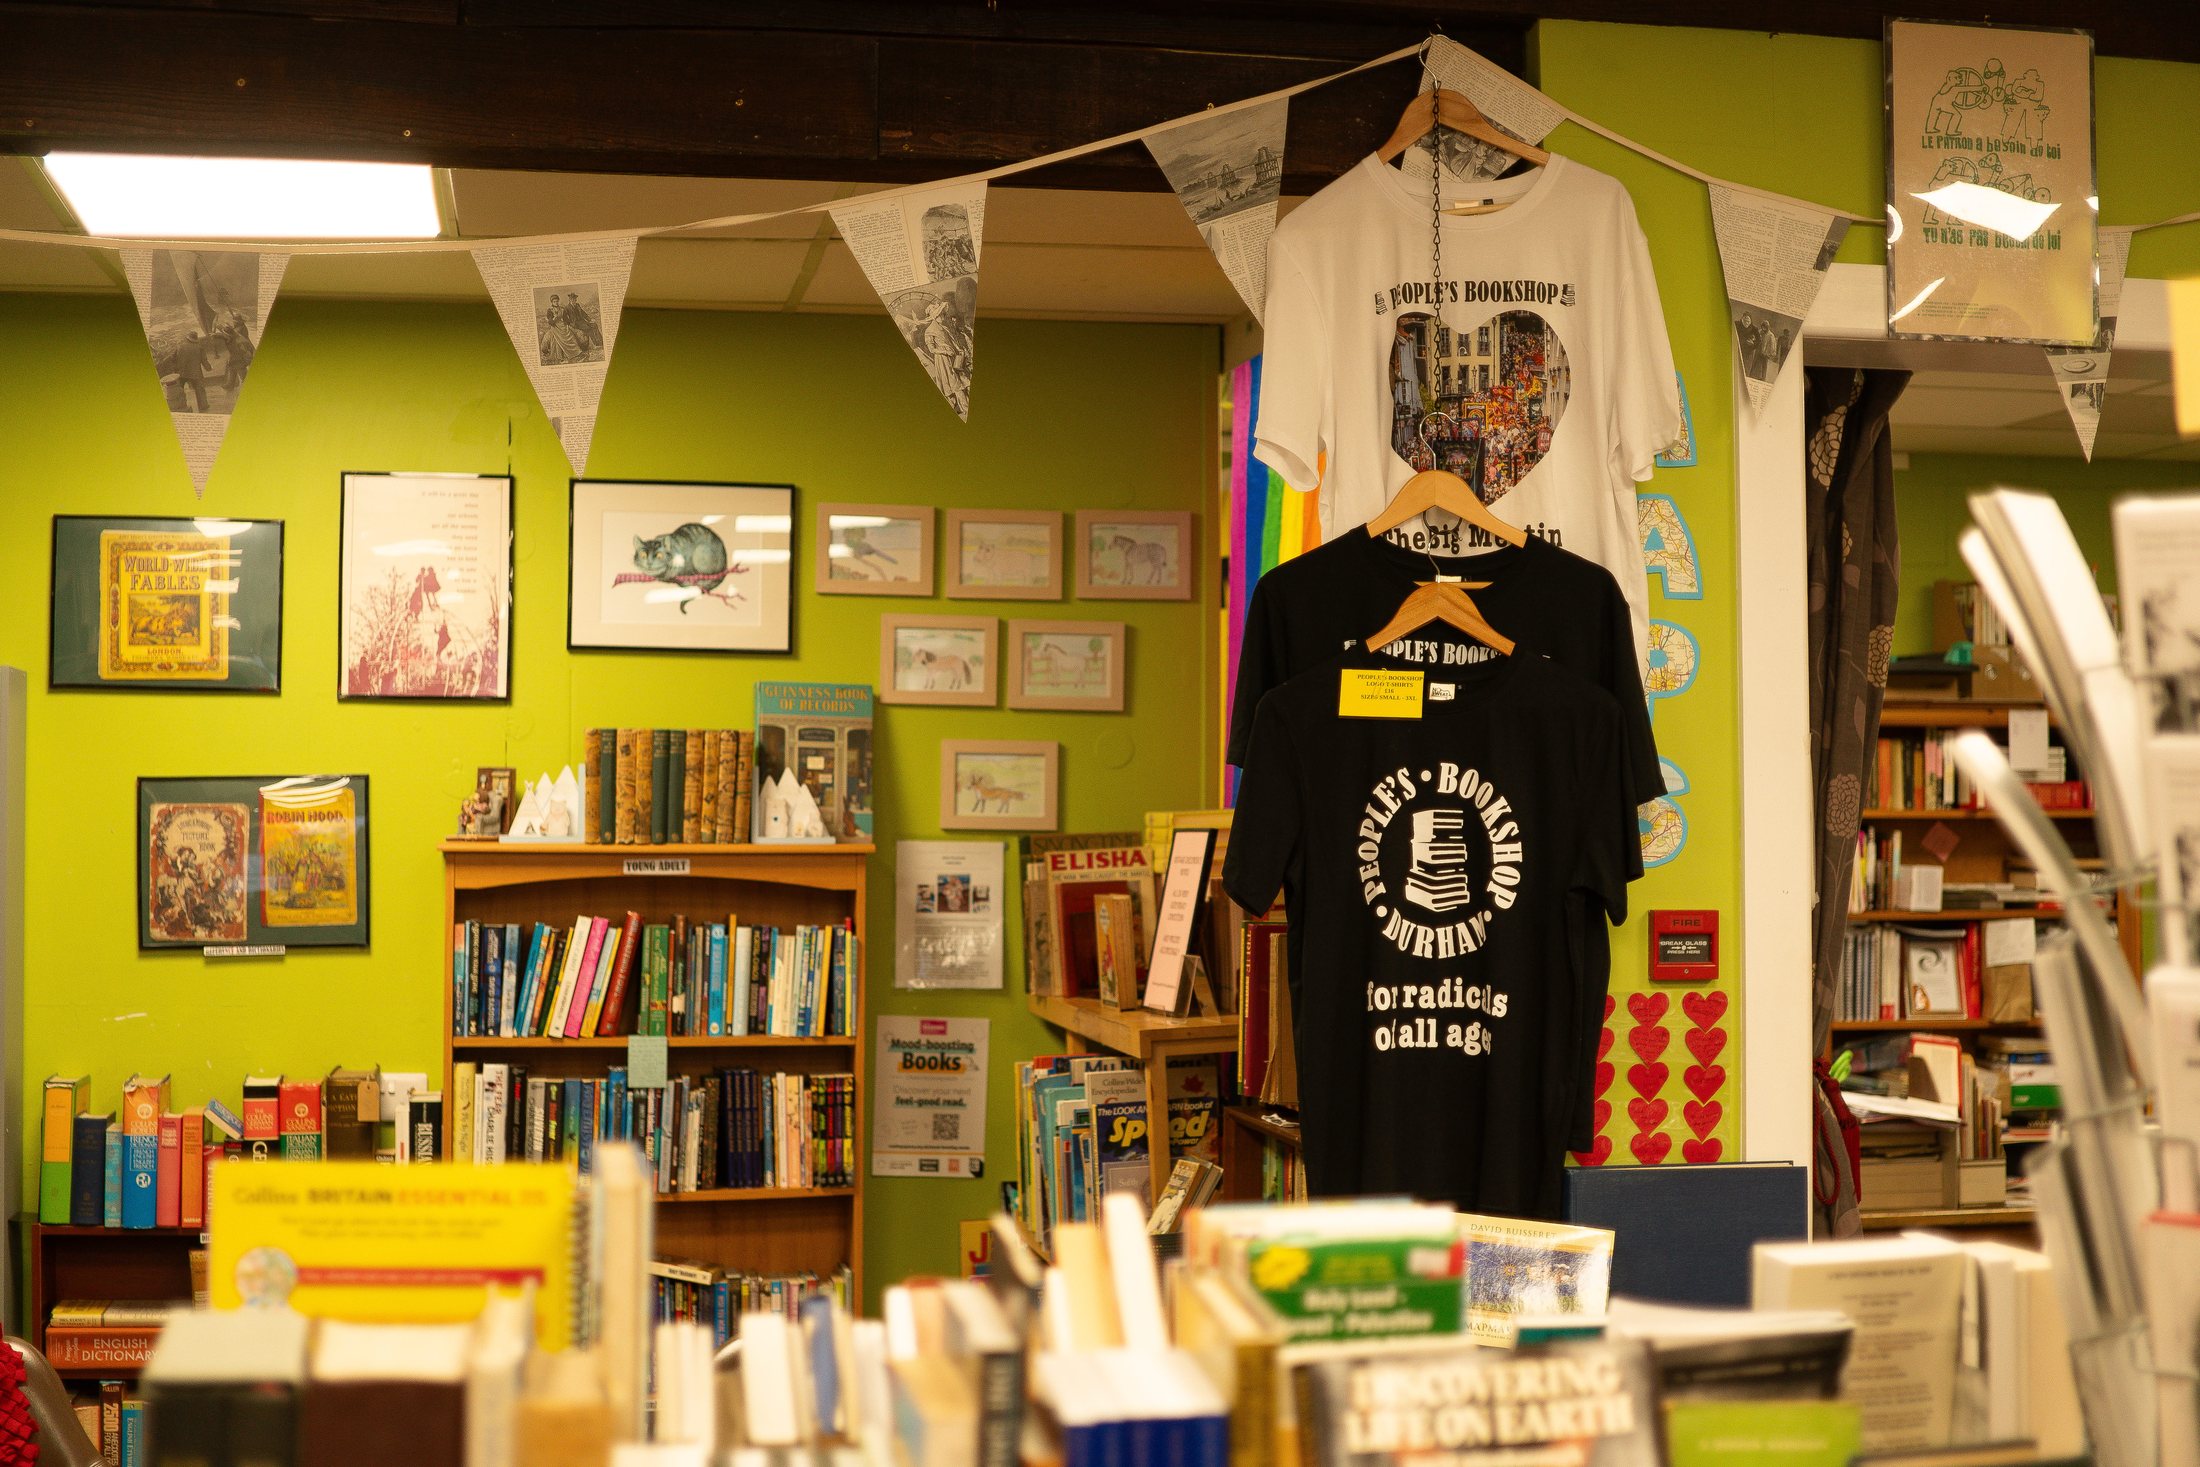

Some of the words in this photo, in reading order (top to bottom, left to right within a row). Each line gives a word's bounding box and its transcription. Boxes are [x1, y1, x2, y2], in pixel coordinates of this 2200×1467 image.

[1921, 135, 1934, 149] LE
[2047, 229, 2061, 251] lui
[1390, 280, 1458, 310] PEOPLE'S
[1465, 280, 1559, 305] BOOKSHOP
[1468, 522, 1563, 548] Metin
[130, 575, 200, 591] FABLES
[1380, 639, 1438, 664] PLE'S
[1388, 674, 1423, 682] BOOKSHOP
[765, 685, 831, 700] GUINNESS
[835, 688, 868, 701] BOOK
[779, 699, 796, 711] OF
[800, 699, 855, 713] RECORDS
[266, 809, 305, 824] ROBIN
[1358, 767, 1417, 906] PEOPLE'S
[1437, 762, 1523, 910] BOOKSHOP
[626, 861, 656, 872] YOUNG
[658, 861, 686, 872] ADULT
[1050, 850, 1147, 872] ELISHA
[1672, 919, 1701, 927] FIRE
[1382, 907, 1487, 960] DURHAM
[1367, 981, 1398, 1012] for
[1399, 1017, 1438, 1048] all
[891, 1038, 975, 1053] Mood-boosting
[902, 1052, 961, 1071] Books
[895, 1096, 941, 1108] feel-good
[1097, 1107, 1112, 1117] The
[1113, 1105, 1133, 1116] LOOK
[1184, 1101, 1203, 1111] book
[1109, 1110, 1210, 1147] Sped
[1470, 1223, 1502, 1234] DAVID
[1506, 1227, 1557, 1240] BUISSERET
[93, 1338, 148, 1350] ENGLISH
[82, 1350, 158, 1362] DICTIONARY
[103, 1402, 119, 1432] 2500
